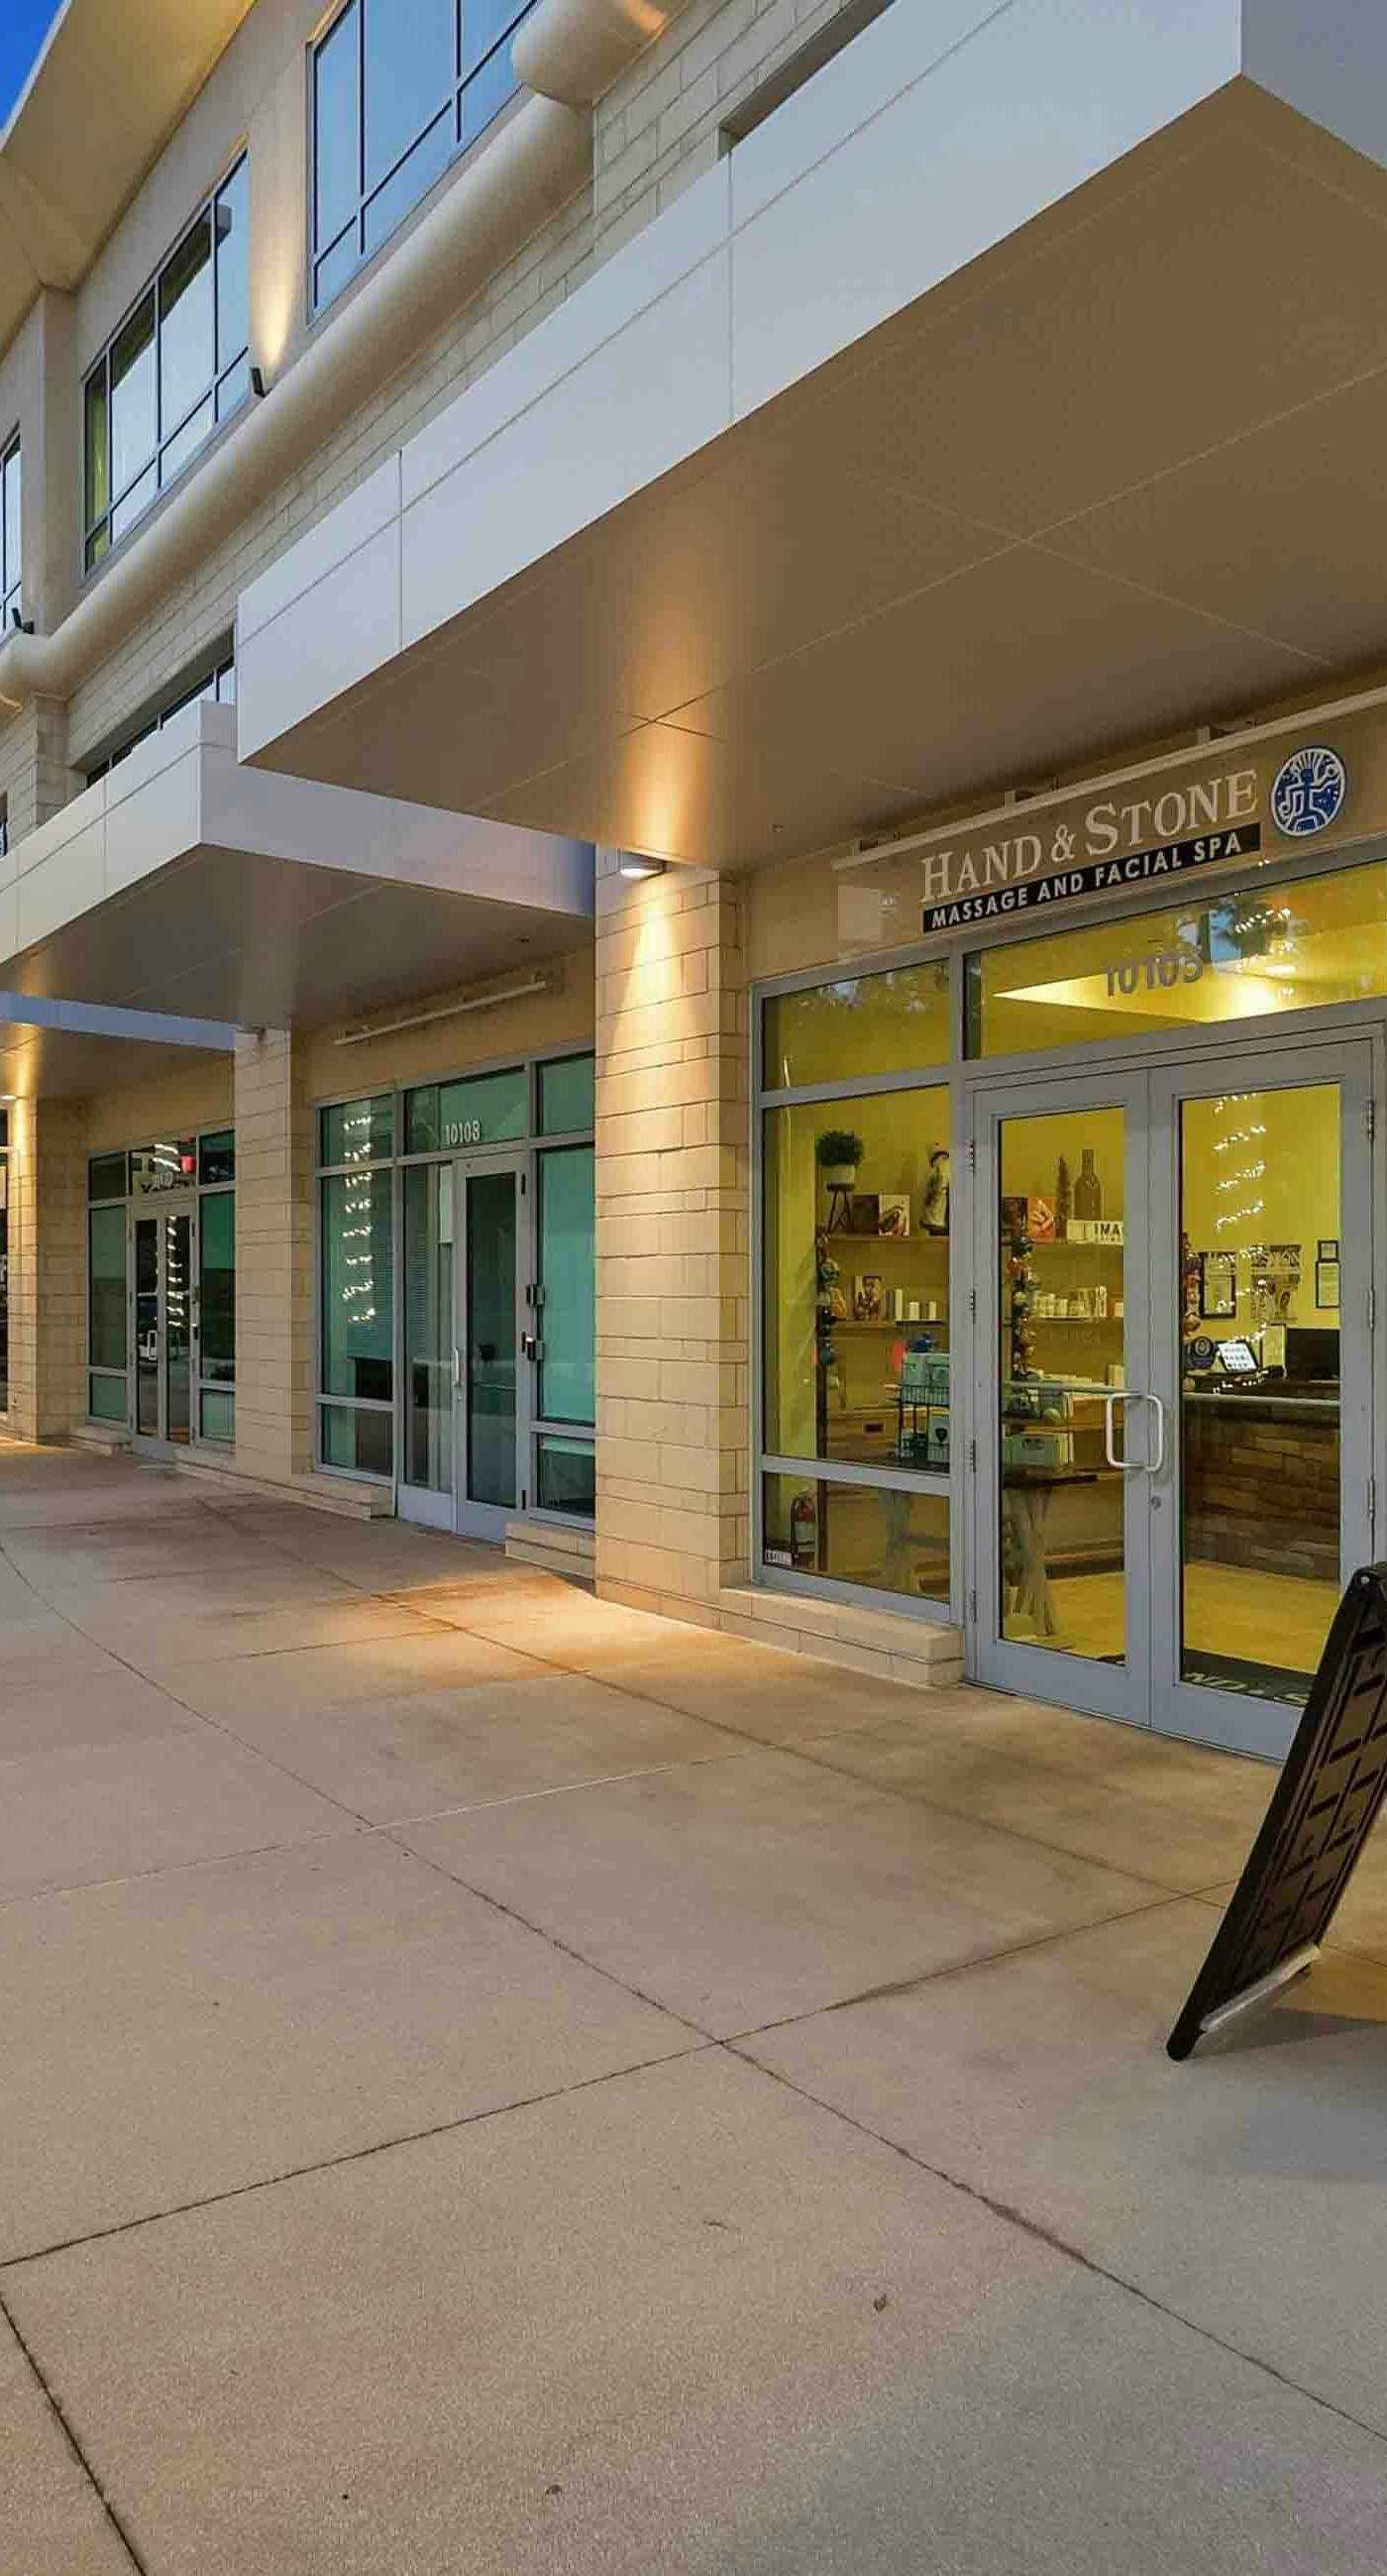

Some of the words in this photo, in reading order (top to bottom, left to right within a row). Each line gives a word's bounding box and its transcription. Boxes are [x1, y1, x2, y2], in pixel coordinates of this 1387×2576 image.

[920, 834, 1041, 904] HAND
[1050, 823, 1076, 862] &
[1084, 768, 1258, 856] STONE
[930, 887, 1028, 928] MASSAGE
[1036, 872, 1084, 902] AND
[1095, 847, 1183, 888] FACIAL
[1193, 831, 1242, 862] SPA
[445, 1120, 480, 1143] 10108
